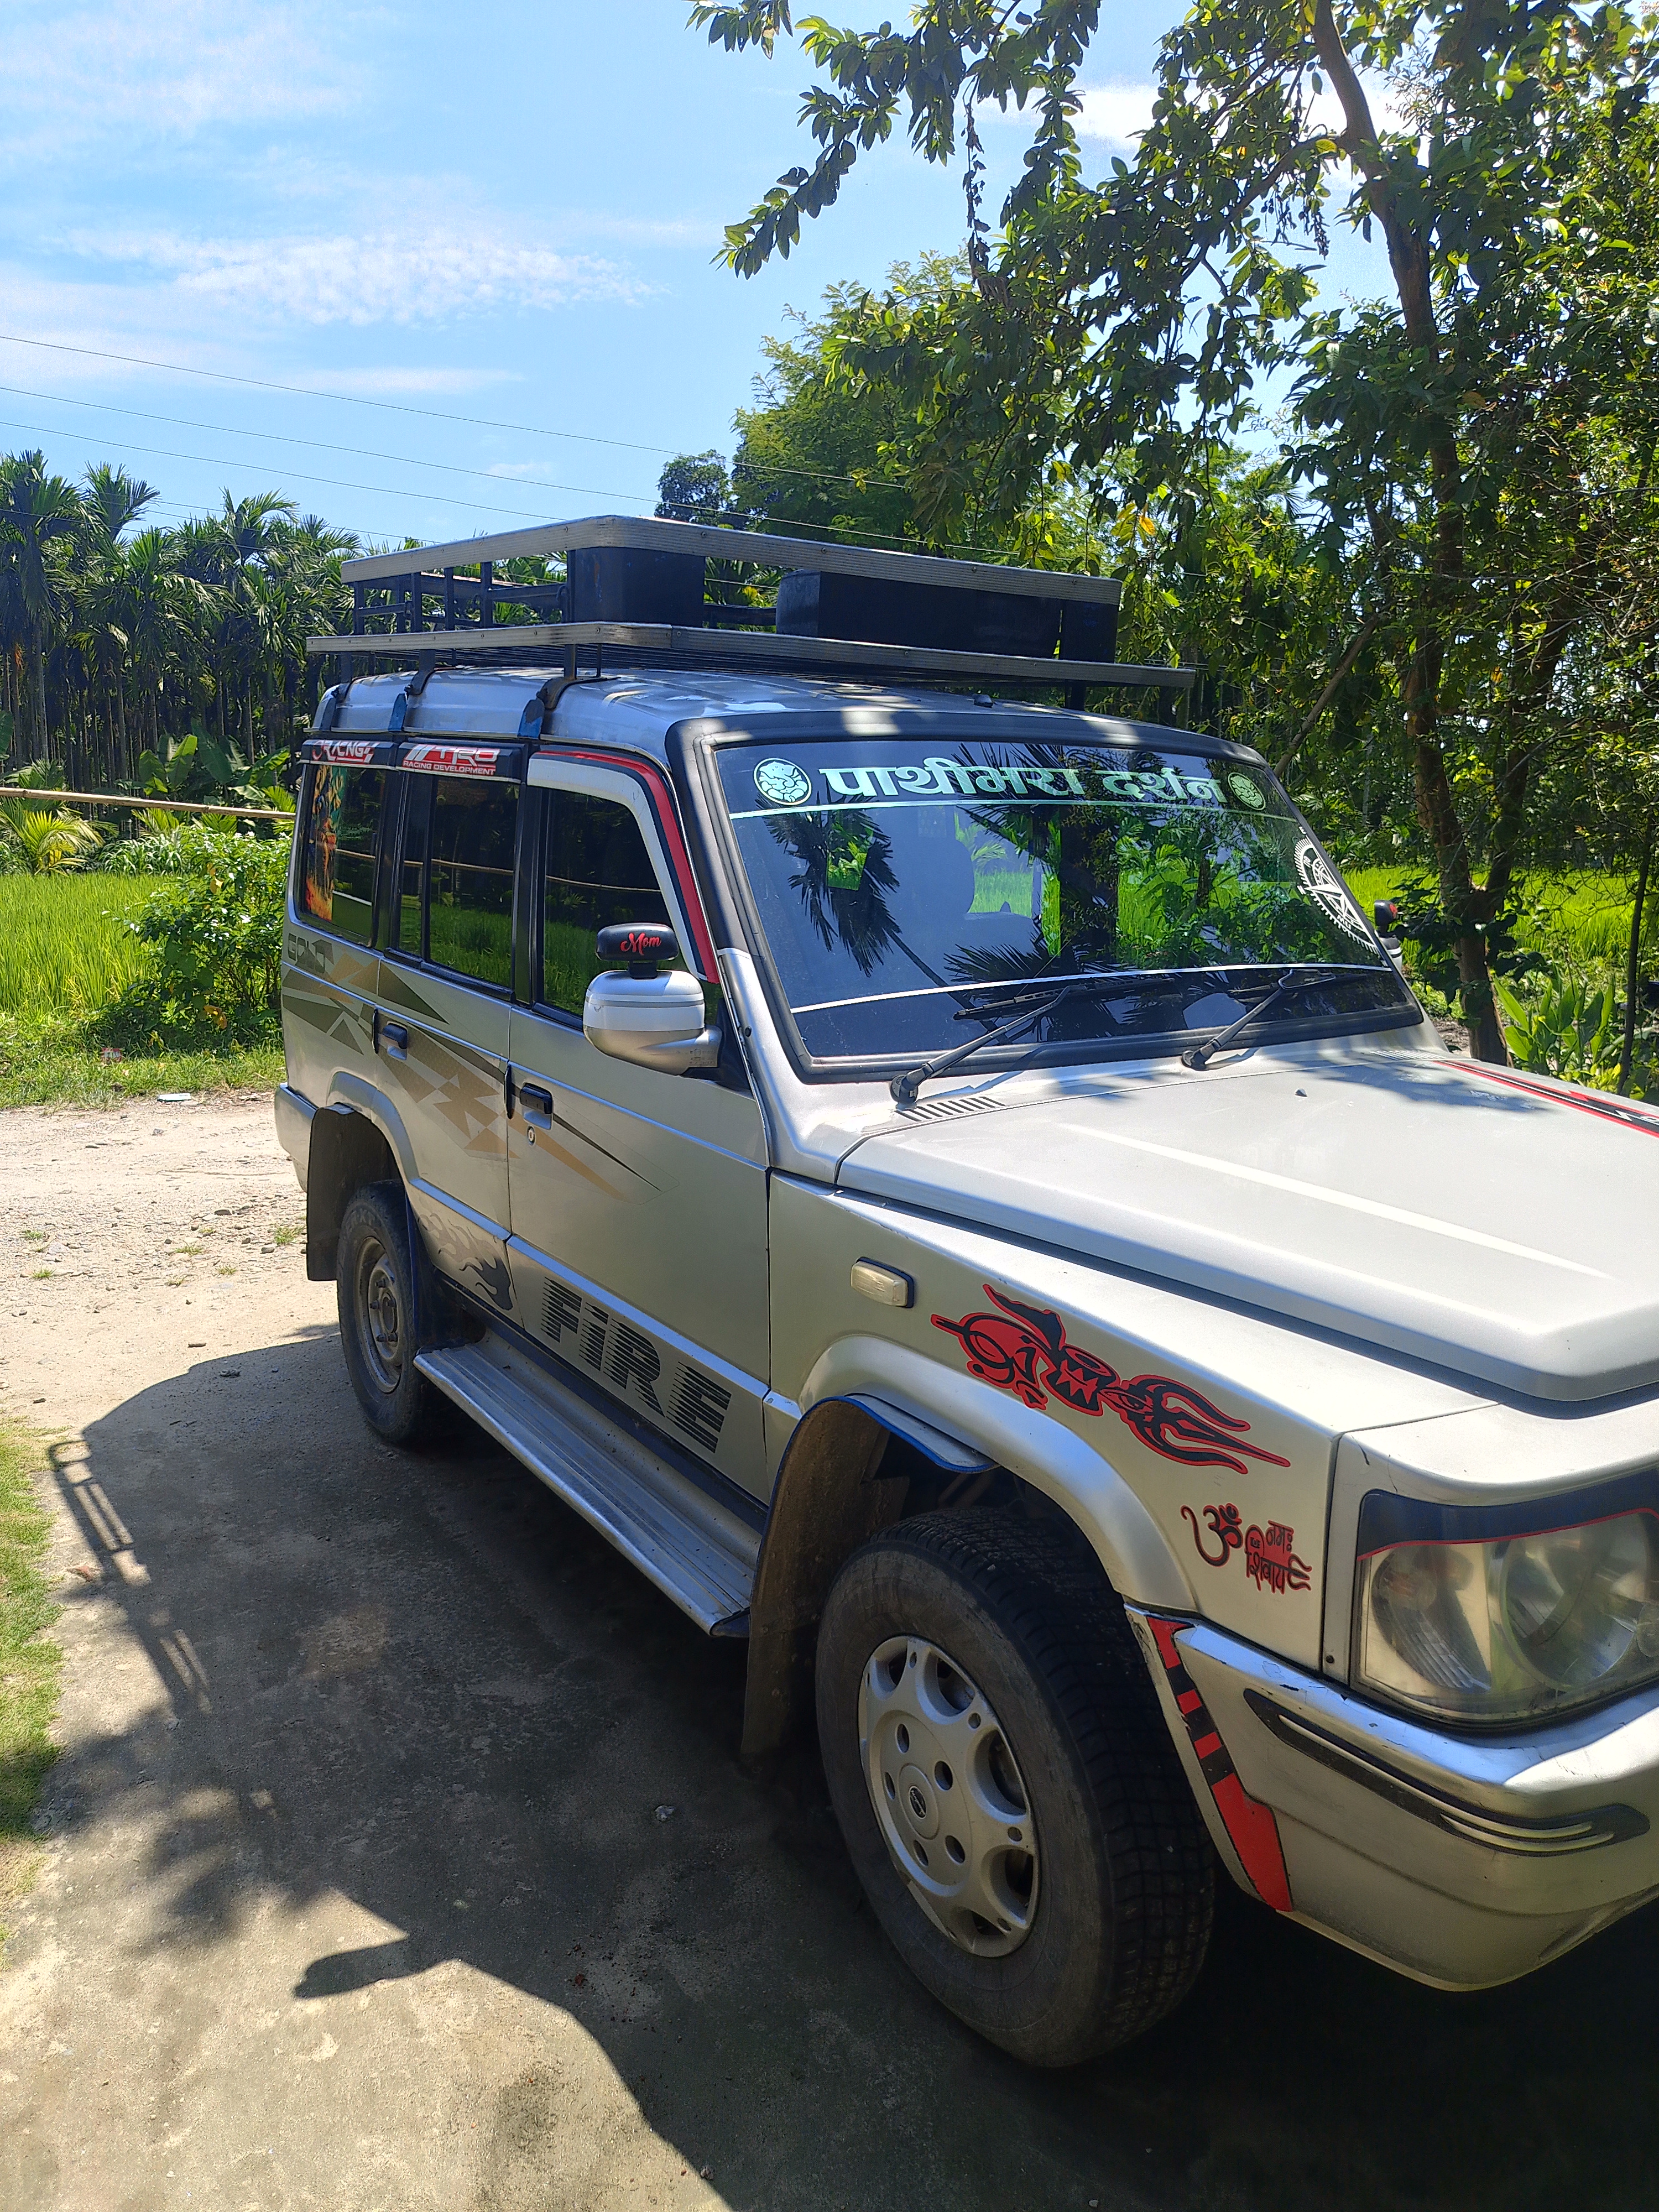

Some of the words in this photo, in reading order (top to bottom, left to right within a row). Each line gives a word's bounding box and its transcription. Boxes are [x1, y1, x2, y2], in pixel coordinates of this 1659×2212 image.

[403, 760, 432, 770] RACING
[434, 764, 496, 775] DEVELOPMENT
[1094, 768, 1228, 803] दर्शन
[619, 932, 662, 956] Mom
